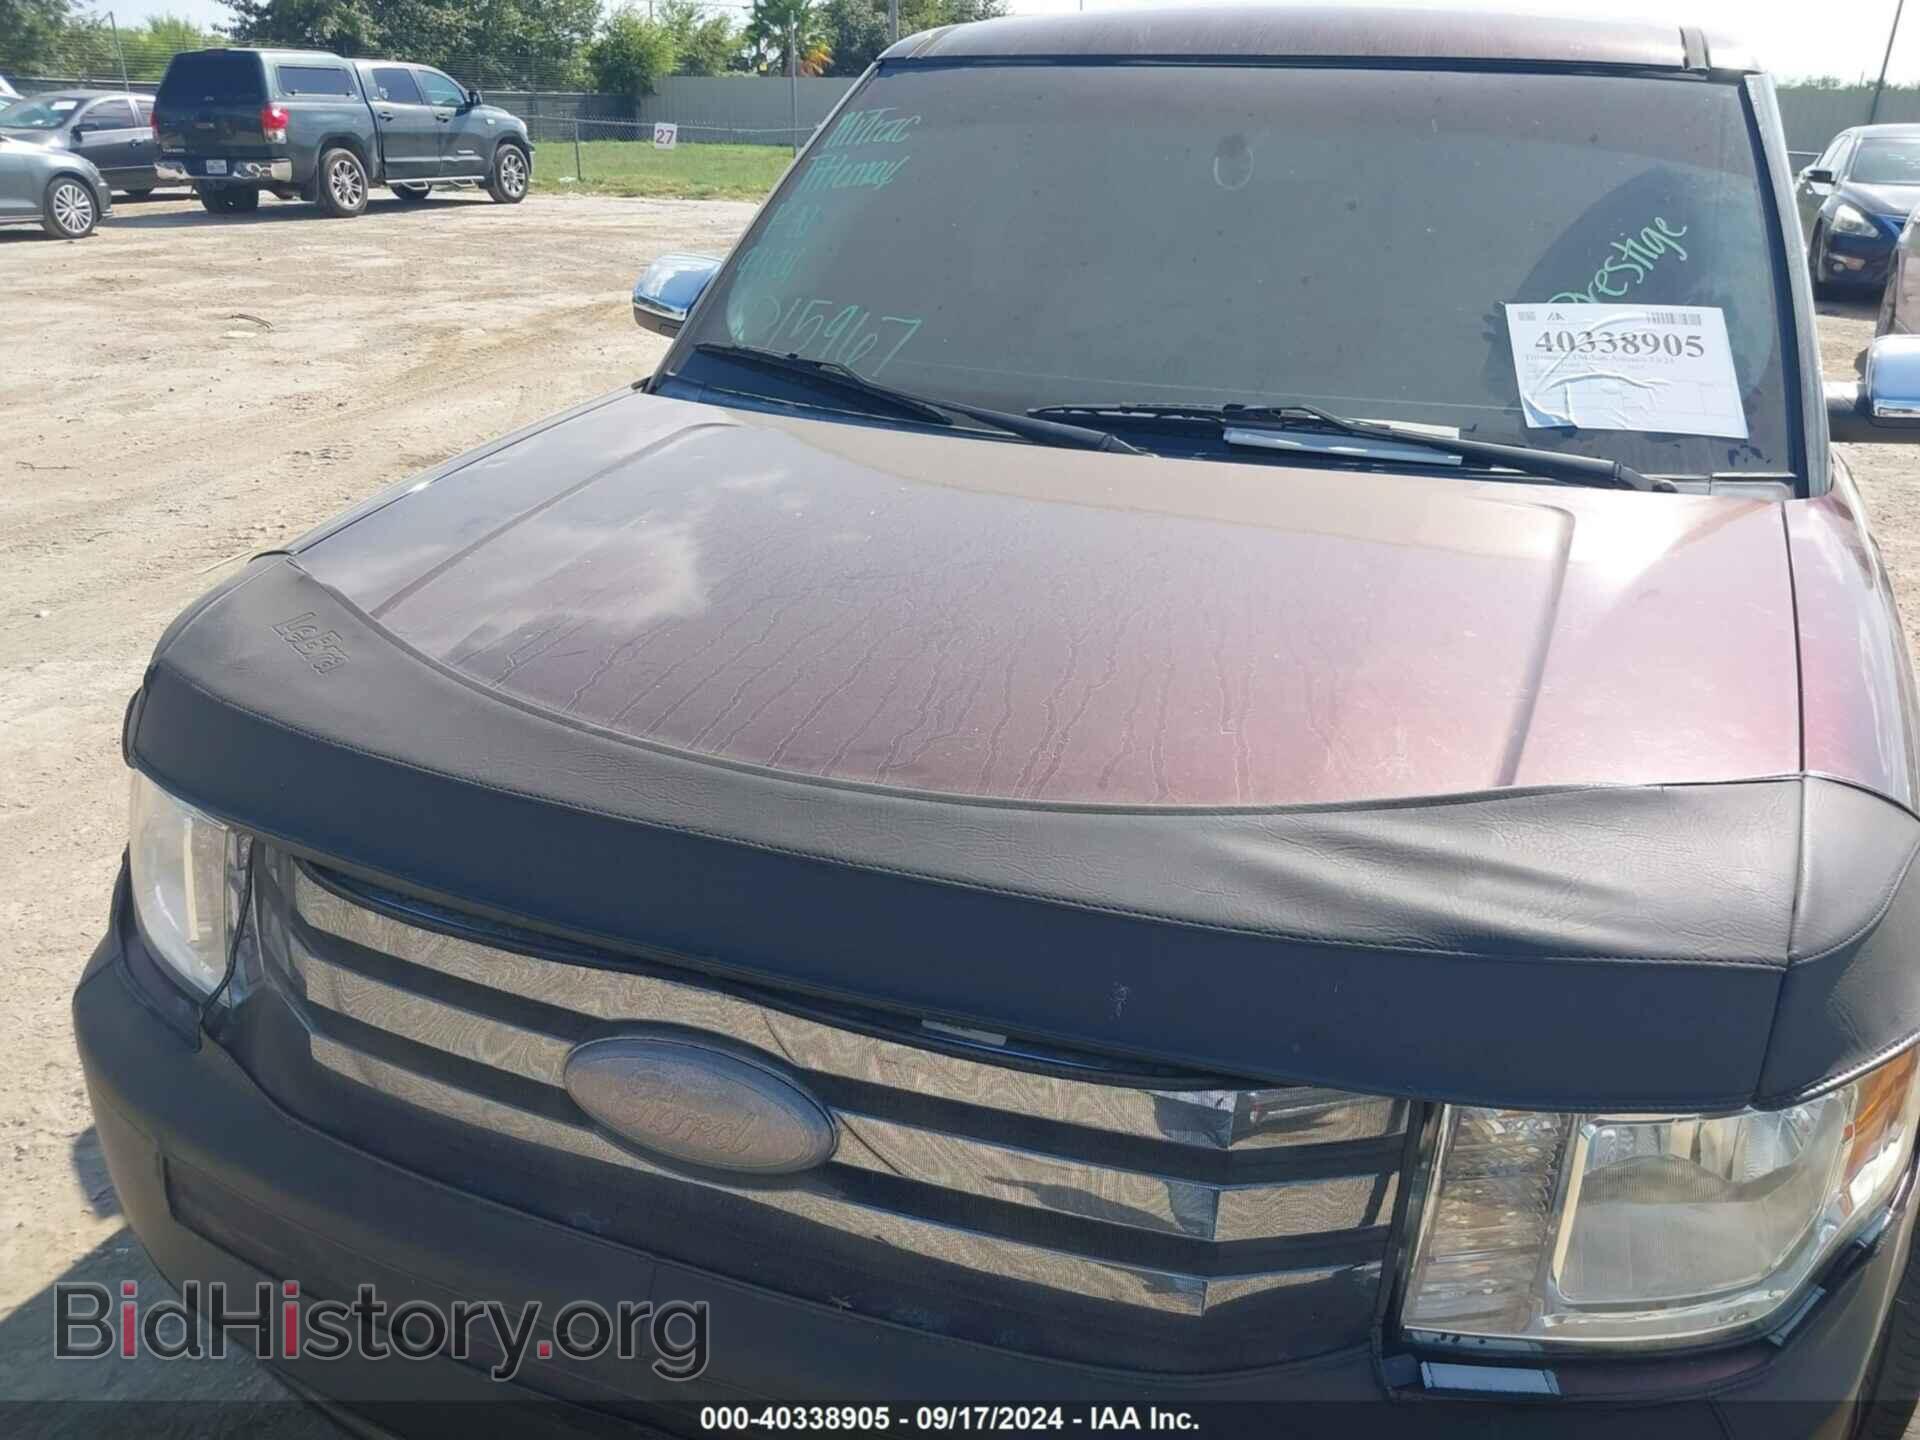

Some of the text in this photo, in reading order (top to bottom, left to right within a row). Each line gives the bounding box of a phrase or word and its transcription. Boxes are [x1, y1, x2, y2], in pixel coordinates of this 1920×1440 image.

[656, 128, 674, 145] 27
[1535, 330, 1705, 357] 40338905
[608, 1070, 757, 1153] Ford
